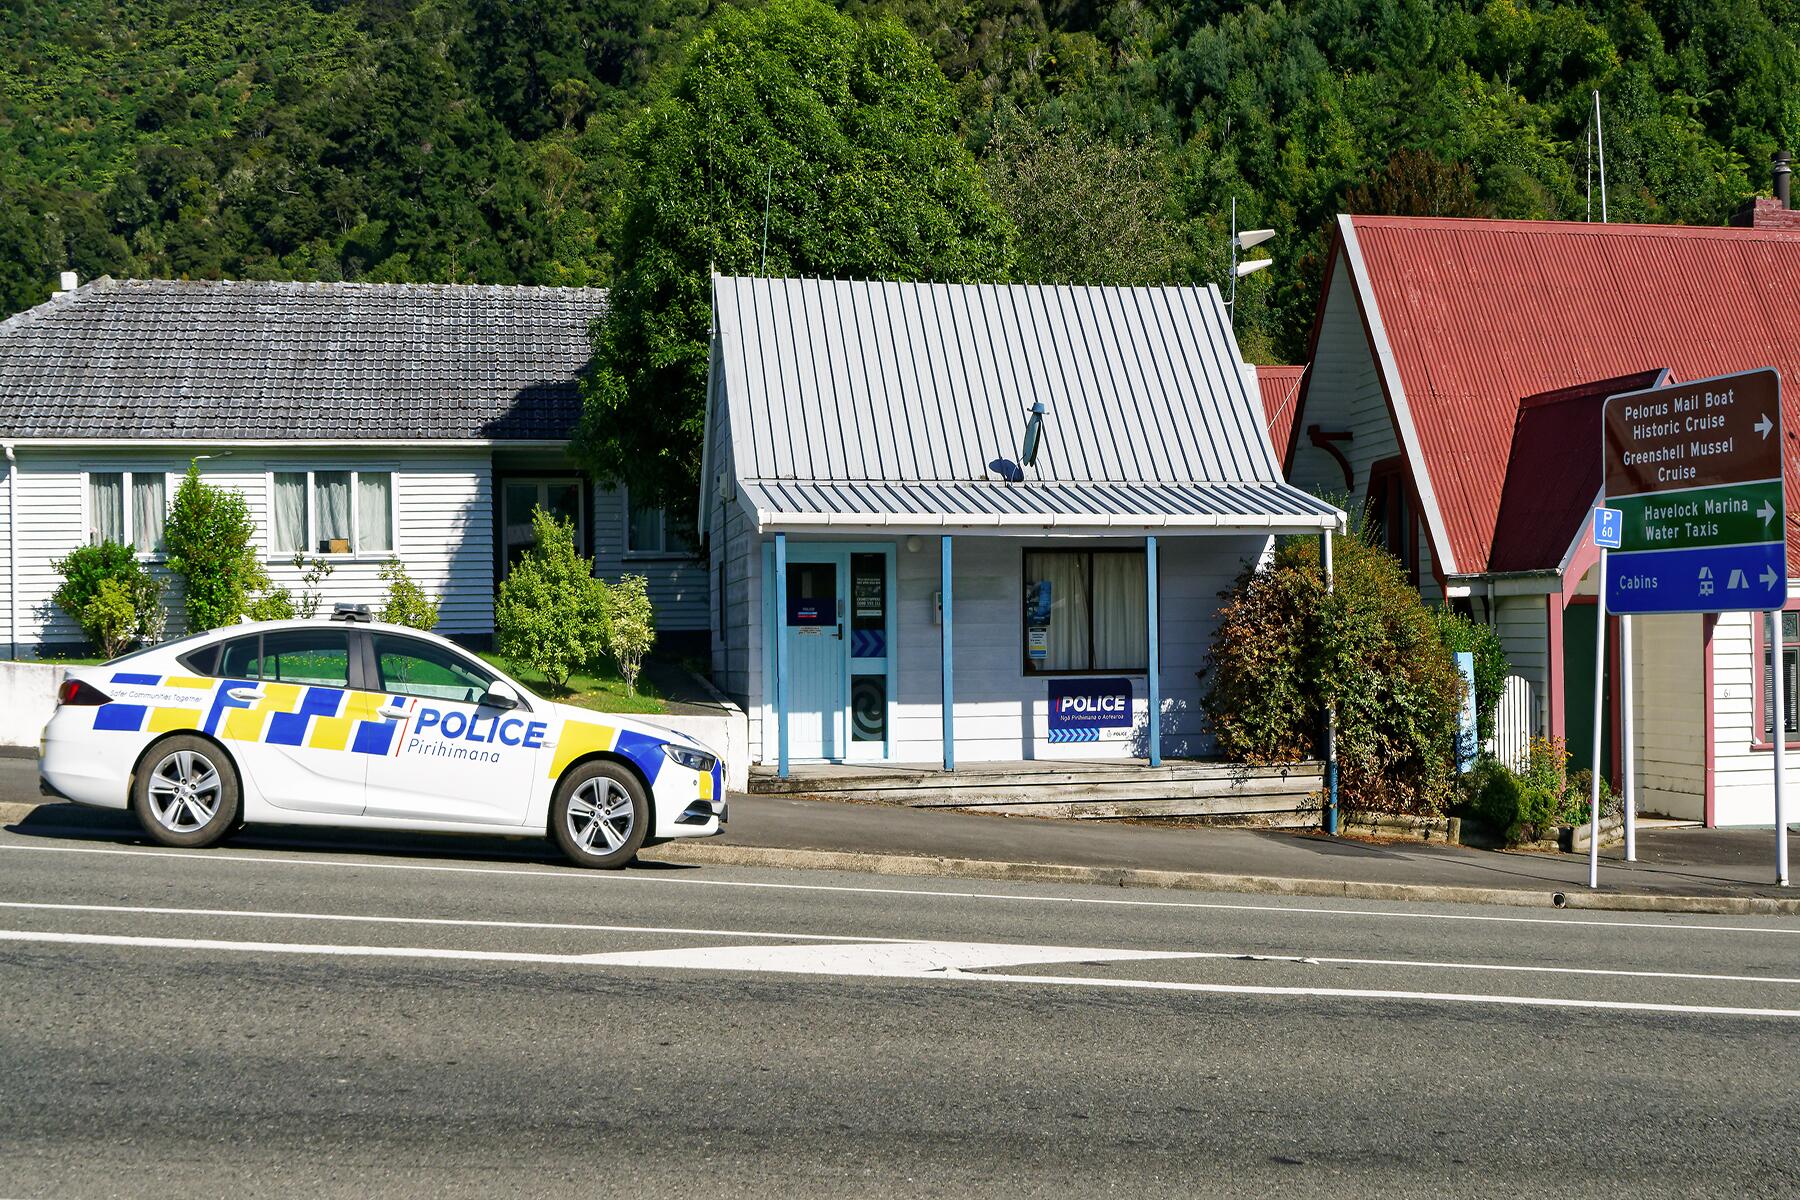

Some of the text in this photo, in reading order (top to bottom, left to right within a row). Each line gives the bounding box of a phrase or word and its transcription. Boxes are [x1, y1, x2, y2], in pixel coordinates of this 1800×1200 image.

[1625, 388, 1734, 421] Pelorus Mail Boat
[1633, 414, 1725, 440] Historic Cruise
[1623, 437, 1733, 466] Greenshell Mussel
[1657, 465, 1696, 482] Cruise
[1603, 511, 1612, 525] P
[1644, 497, 1748, 521] Havelock Marina
[1601, 526, 1613, 538] 60
[1645, 521, 1719, 541] Water Taxis
[1619, 574, 1658, 590] Cabins
[110, 689, 203, 703] Safer Communities Together
[1061, 695, 1126, 712] POLICE
[414, 708, 548, 749] POLICE
[407, 738, 501, 763] Pirihimana
